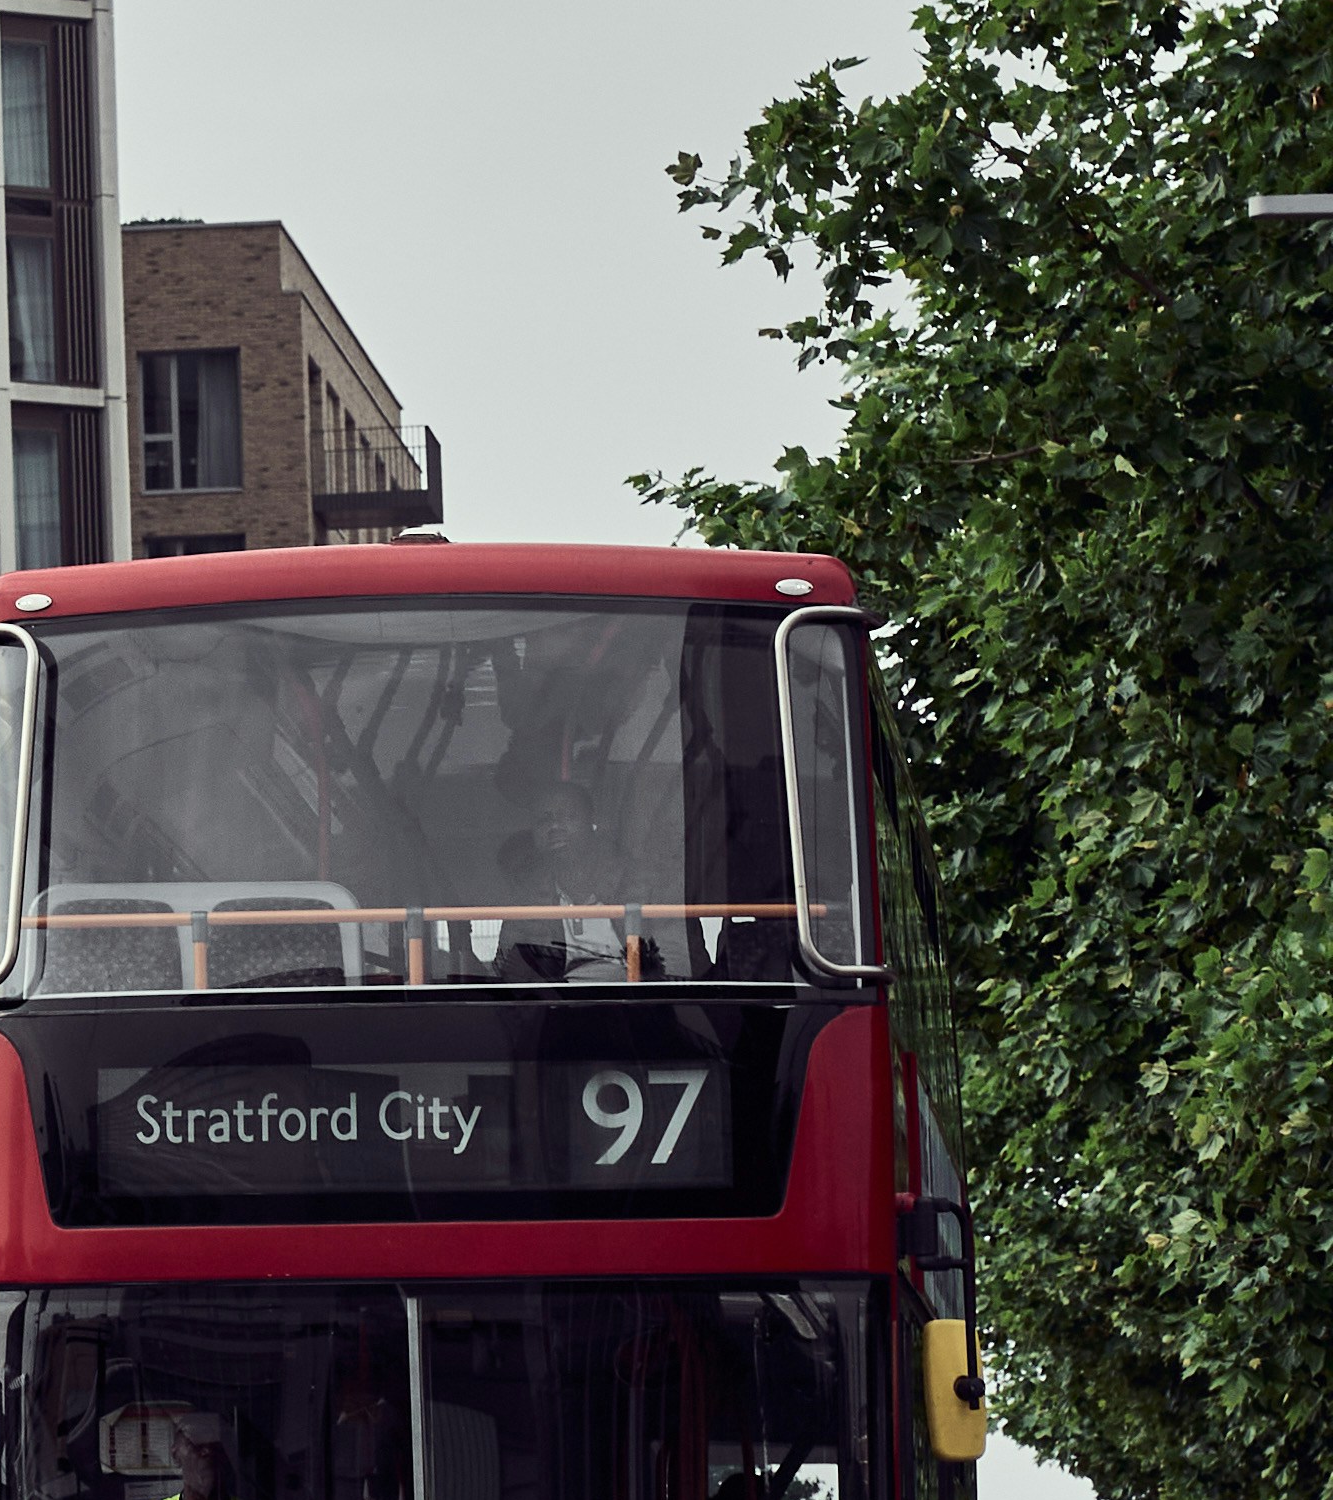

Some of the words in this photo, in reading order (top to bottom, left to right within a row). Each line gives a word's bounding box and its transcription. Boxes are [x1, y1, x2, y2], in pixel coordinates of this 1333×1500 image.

[136, 1092, 358, 1145] Stratford
[379, 1090, 482, 1154] City
[582, 1069, 709, 1165] 97
